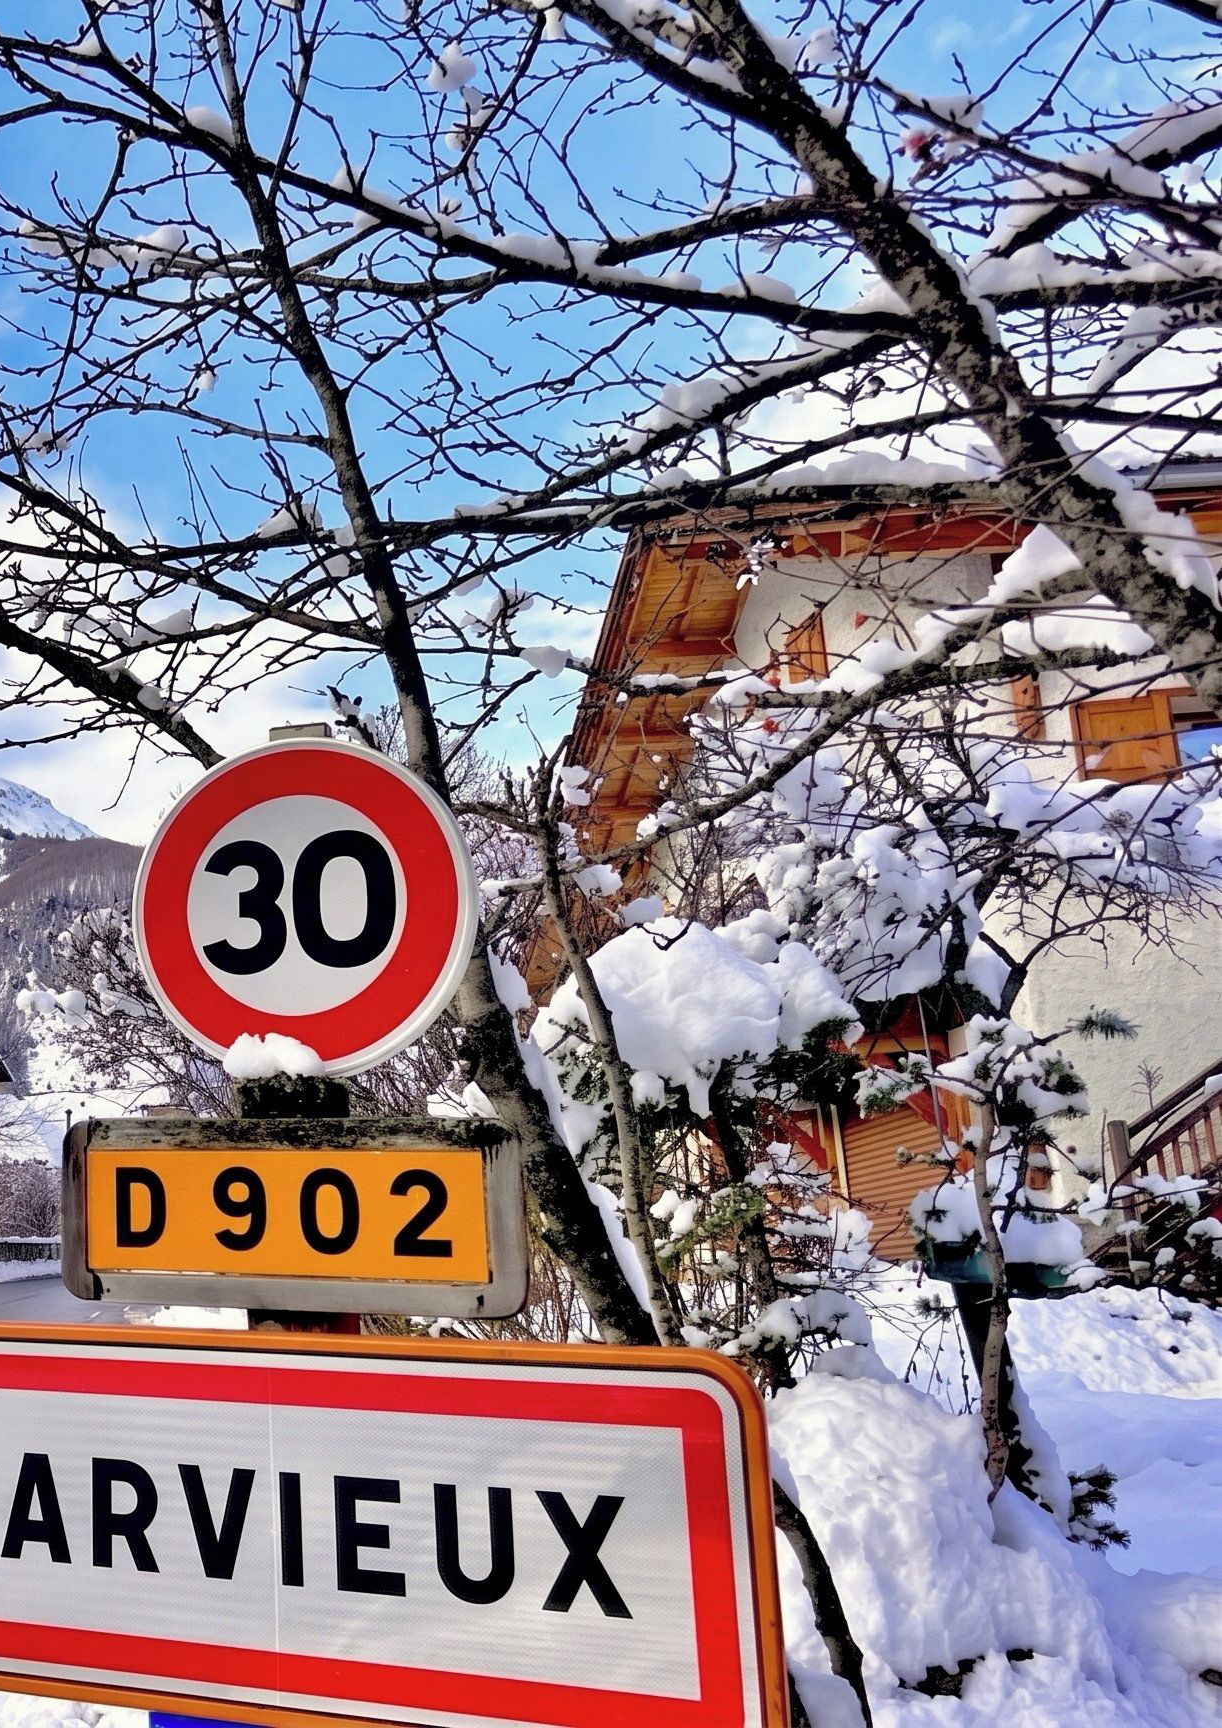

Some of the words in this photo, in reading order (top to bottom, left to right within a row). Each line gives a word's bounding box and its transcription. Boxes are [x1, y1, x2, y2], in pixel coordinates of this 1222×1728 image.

[202, 829, 397, 976] 30
[115, 1166, 167, 1248] D
[212, 1166, 453, 1258] 902
[0, 1452, 634, 1619] ARVIEUX
